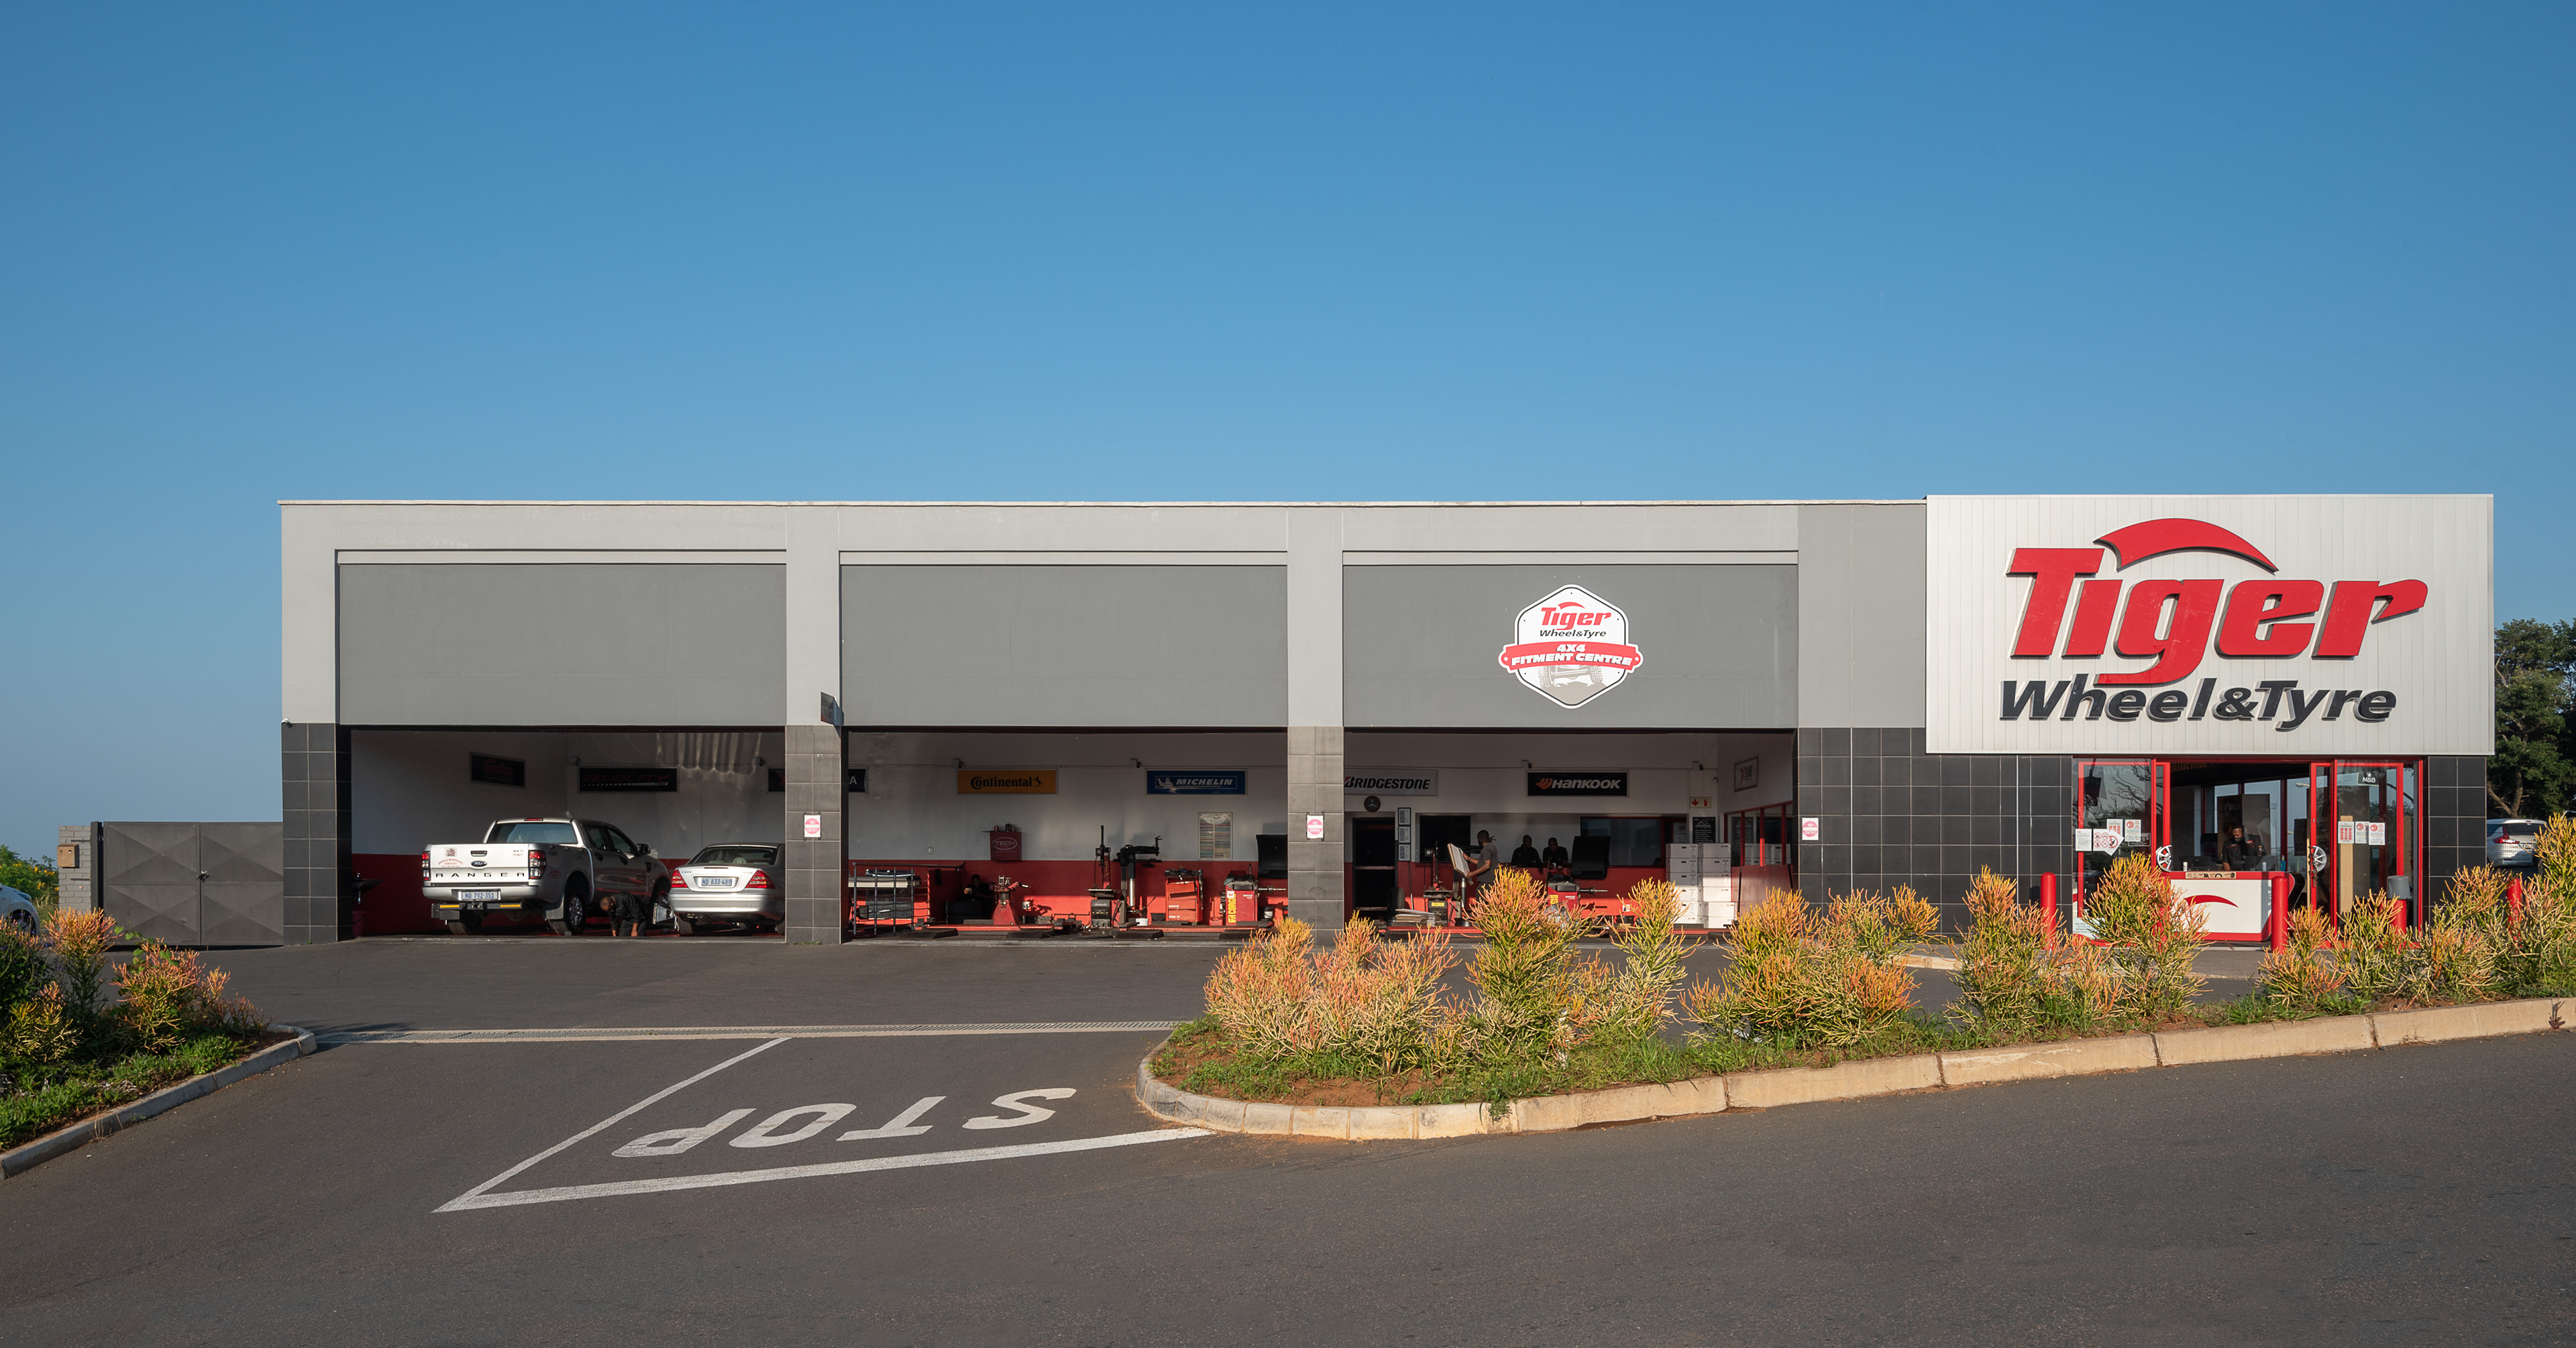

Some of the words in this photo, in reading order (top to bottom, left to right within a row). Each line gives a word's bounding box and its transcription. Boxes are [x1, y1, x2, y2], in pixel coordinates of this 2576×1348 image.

[2005, 519, 2428, 687] Tiger
[1541, 602, 1612, 630] Tiger
[1540, 629, 1607, 638] Wheel&Tyre
[1556, 643, 1586, 654] 4X4
[1511, 653, 1574, 666] FITMENT
[1575, 652, 1633, 666] CENTRE
[1999, 674, 2397, 732] Wheel&Tyre
[584, 774, 672, 782] VELOCITY
[971, 776, 1032, 790] Continental
[1344, 776, 1431, 789] BRIDGESTONE
[611, 1088, 1077, 1157] STOP
